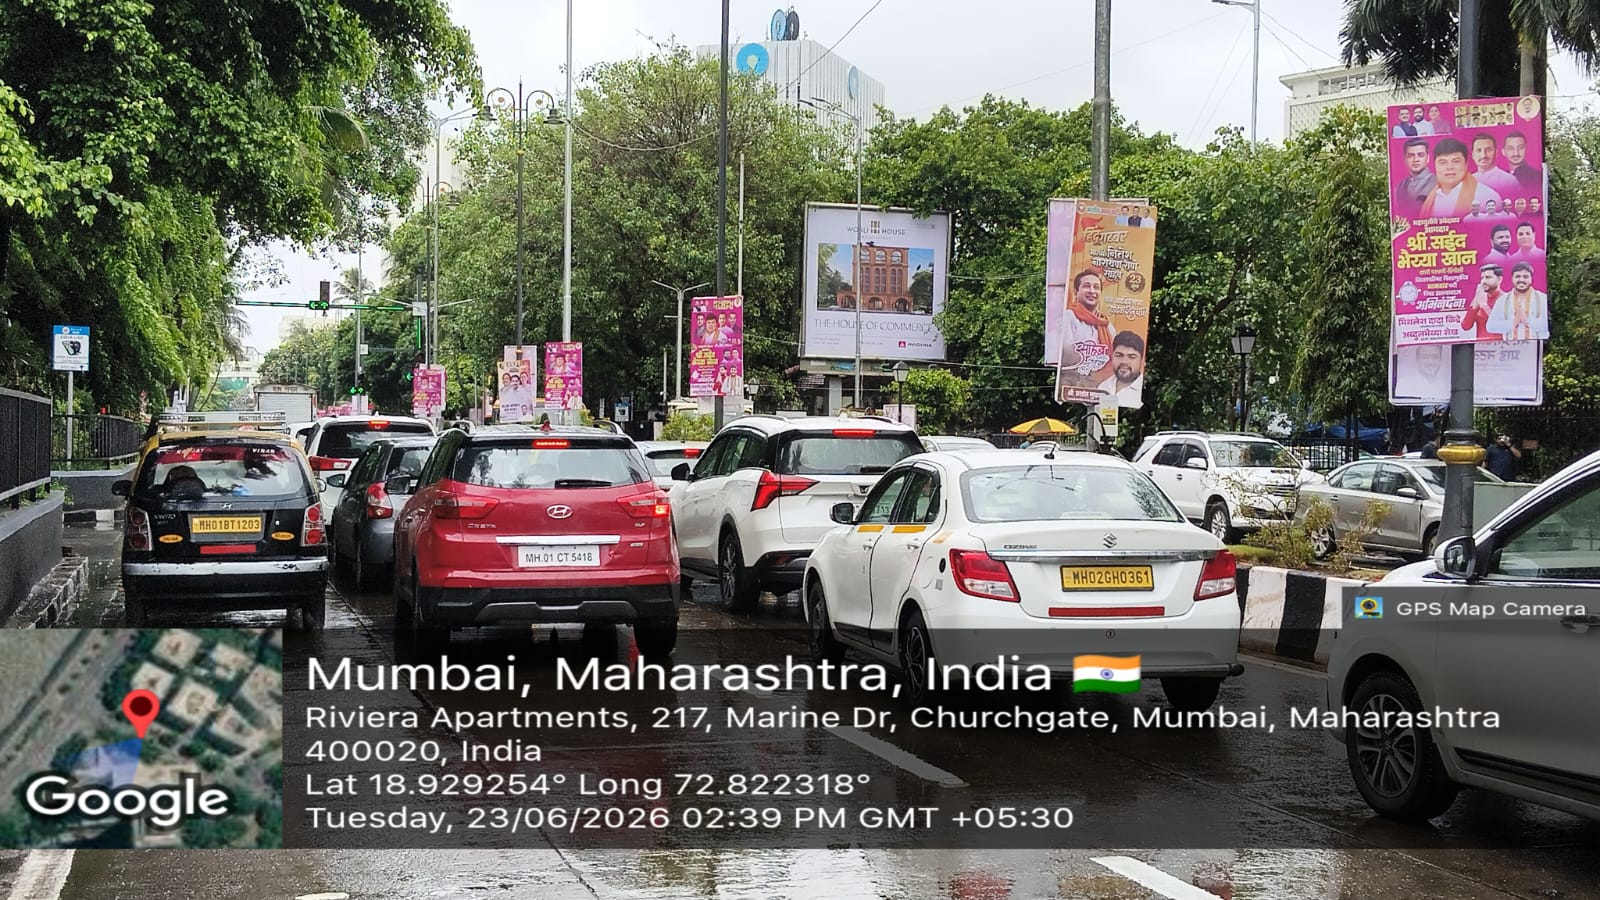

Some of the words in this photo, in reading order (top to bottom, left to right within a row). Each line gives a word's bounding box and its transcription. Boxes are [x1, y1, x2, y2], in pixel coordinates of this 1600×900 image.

[847, 226, 869, 234] WOLI
[881, 228, 906, 236] HOUSE
[1440, 250, 1478, 266] खान
[1130, 274, 1142, 284] 23
[814, 319, 831, 329] THE
[832, 319, 864, 330] HOUE
[866, 320, 880, 331] OF
[199, 520, 260, 531] MH01BT1203
[557, 552, 570, 563] CT
[571, 552, 593, 563] 5418
[1072, 570, 1150, 585] MH02GH0361
